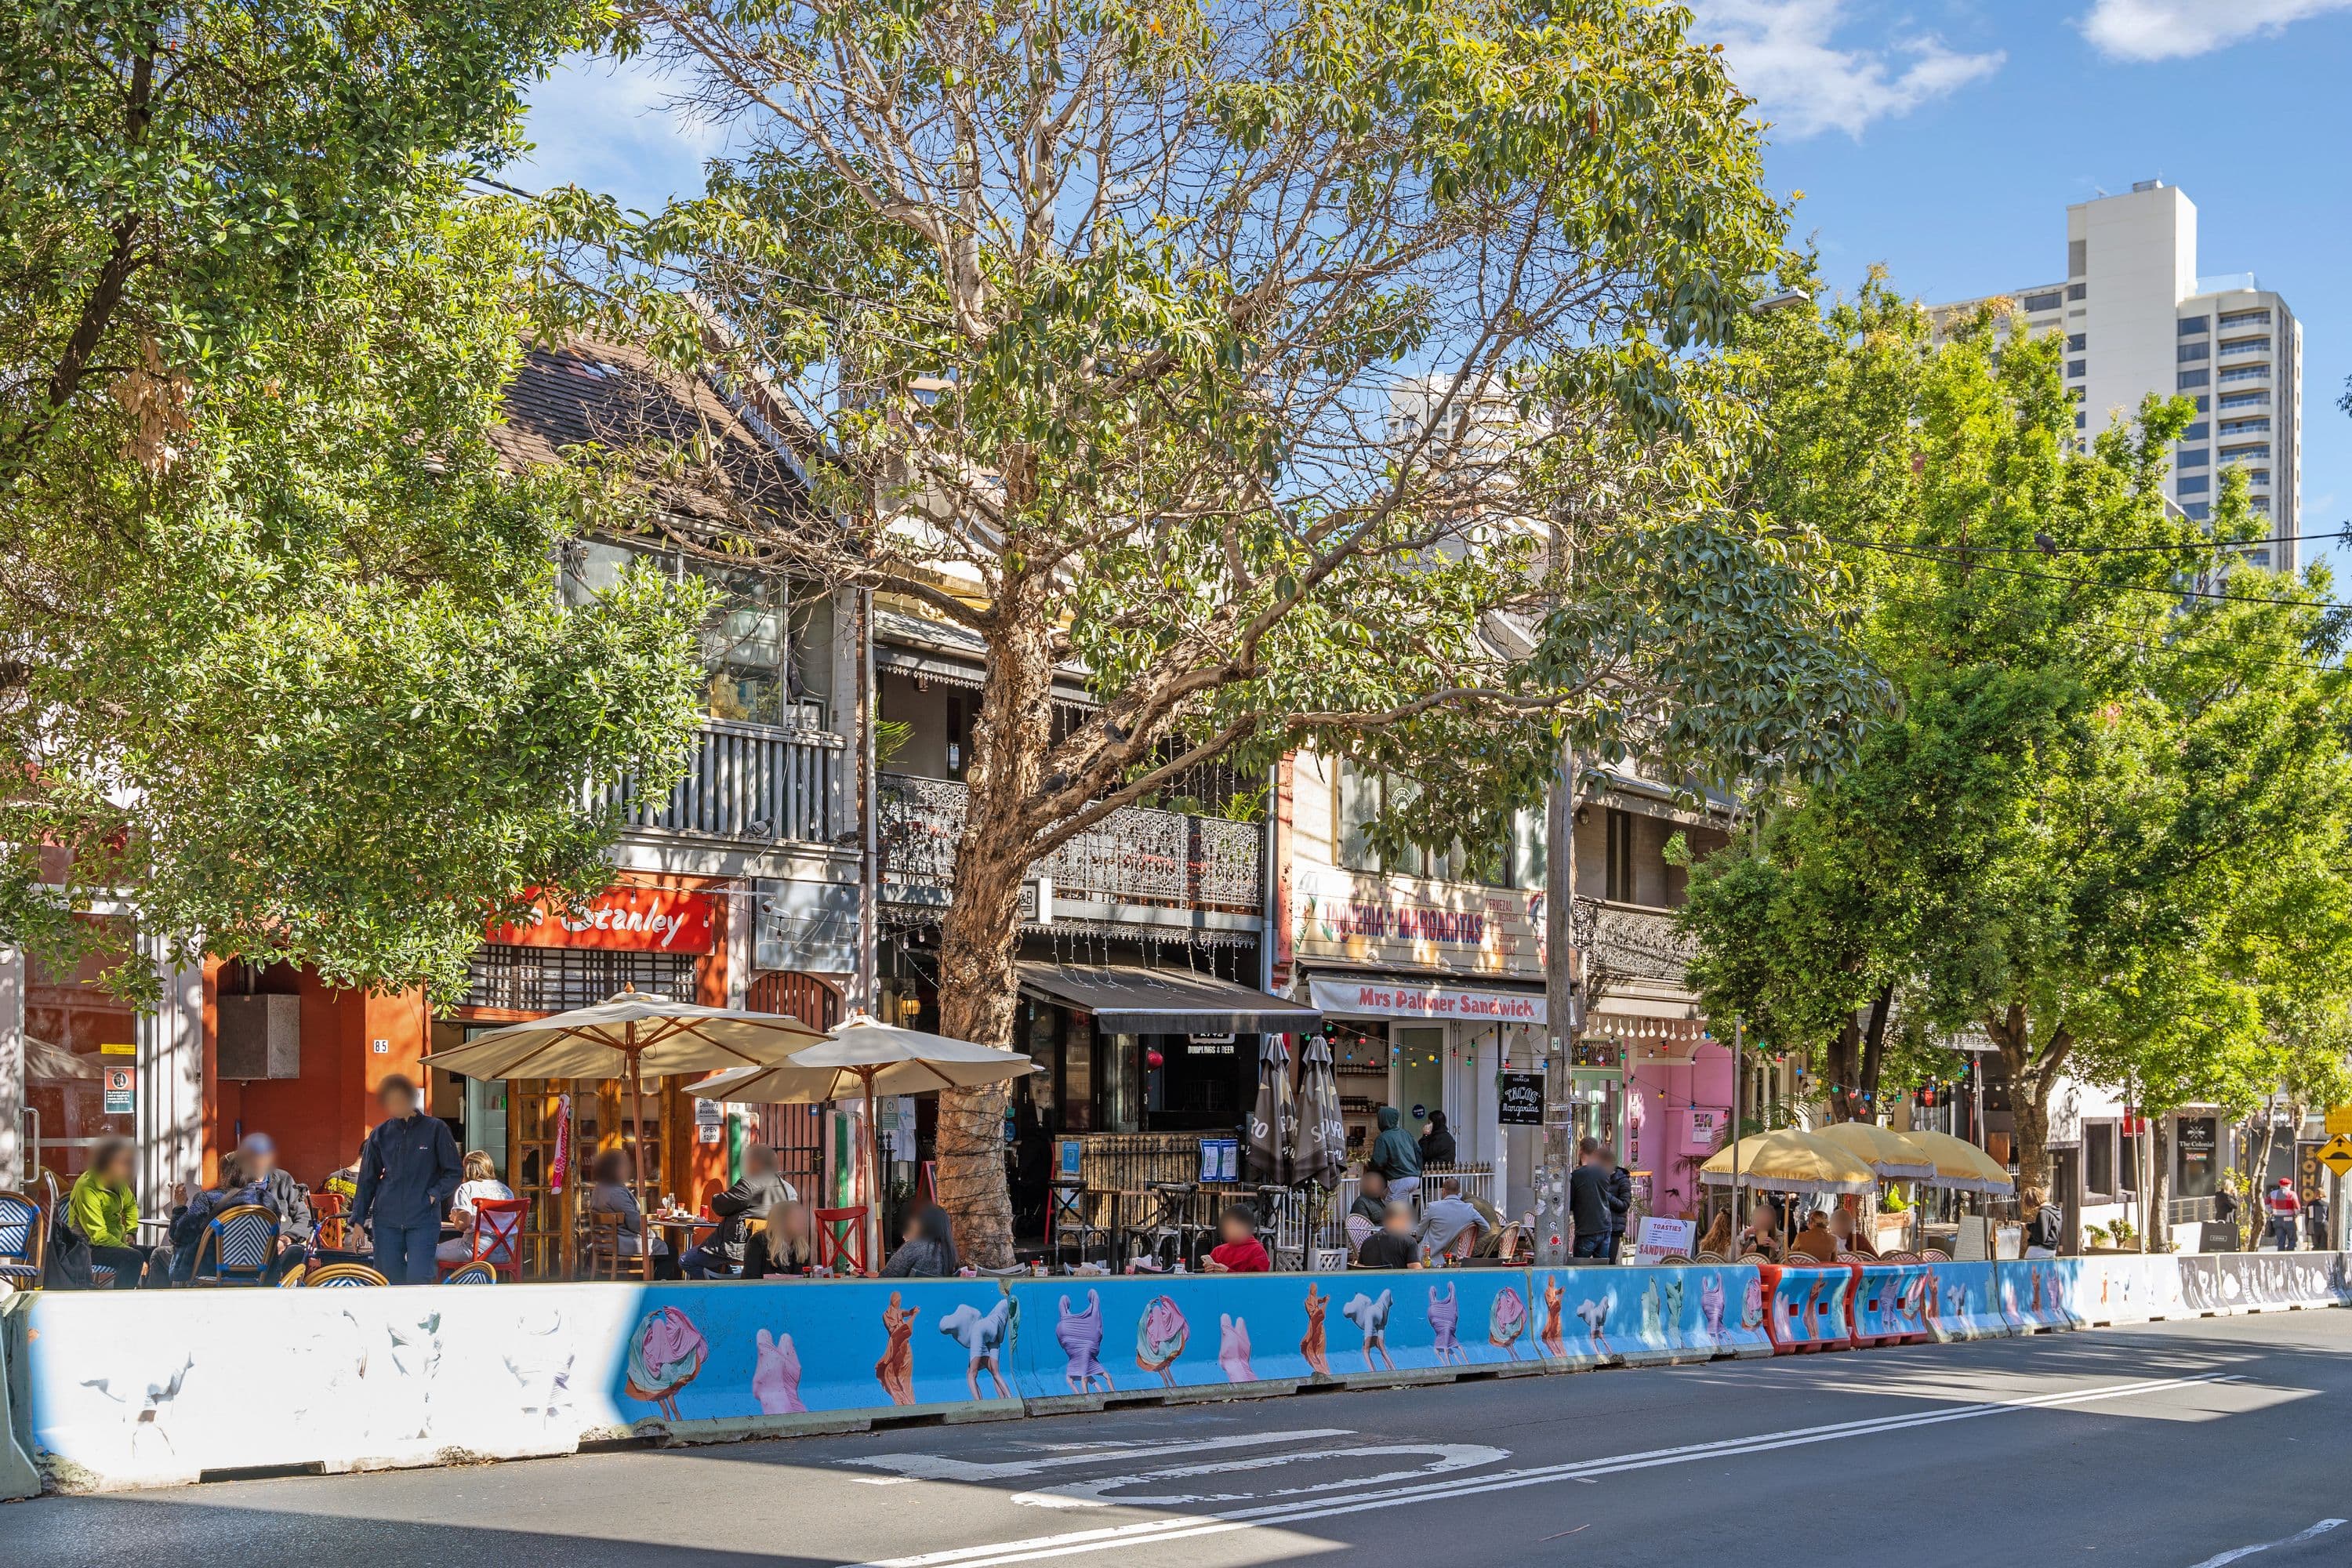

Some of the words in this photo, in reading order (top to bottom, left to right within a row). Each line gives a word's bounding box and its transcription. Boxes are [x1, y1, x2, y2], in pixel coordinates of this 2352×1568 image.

[1018, 890, 1033, 906] &B
[1485, 898, 1513, 912] CERVEZAS
[1325, 902, 1385, 942] TAQUERIA
[1398, 907, 1483, 945] MARGARITAS
[1359, 987, 1391, 1007] Mrs
[1396, 990, 1454, 1012] Palmer
[1460, 995, 1535, 1017] Sandwich
[375, 1040, 387, 1052] 85
[1188, 1045, 1216, 1054] DUMPLINGS
[1221, 1046, 1235, 1054] BEER
[1504, 1086, 1539, 1103] TACOS
[1502, 1102, 1540, 1116] Margaritas
[2302, 1145, 2317, 1203] SOHO
[1653, 1223, 1682, 1232] TOASTIES
